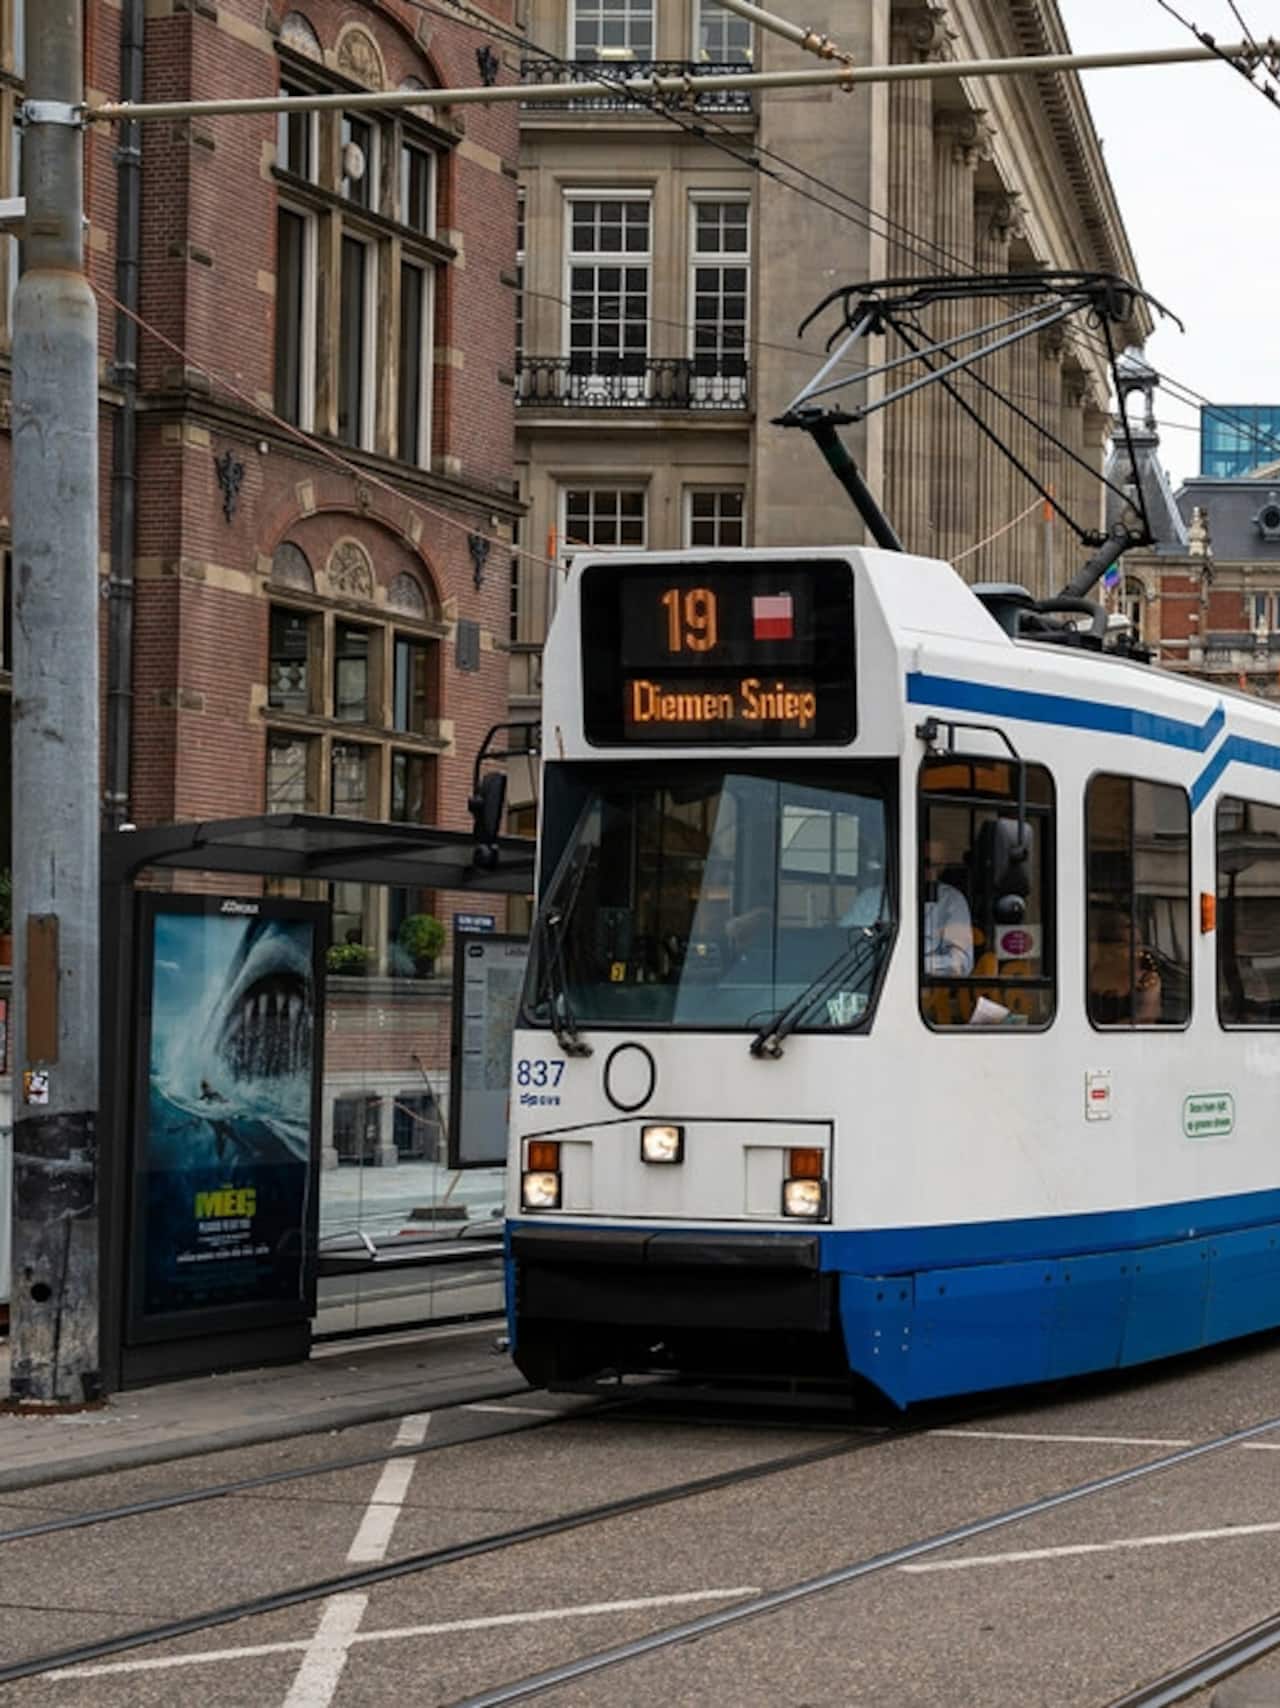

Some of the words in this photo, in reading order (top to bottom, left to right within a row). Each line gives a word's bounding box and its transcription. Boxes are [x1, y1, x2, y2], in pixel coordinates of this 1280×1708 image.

[662, 588, 717, 651] 19
[632, 680, 733, 722] Diemen
[740, 678, 816, 728] Sniep
[517, 1060, 566, 1087] 837
